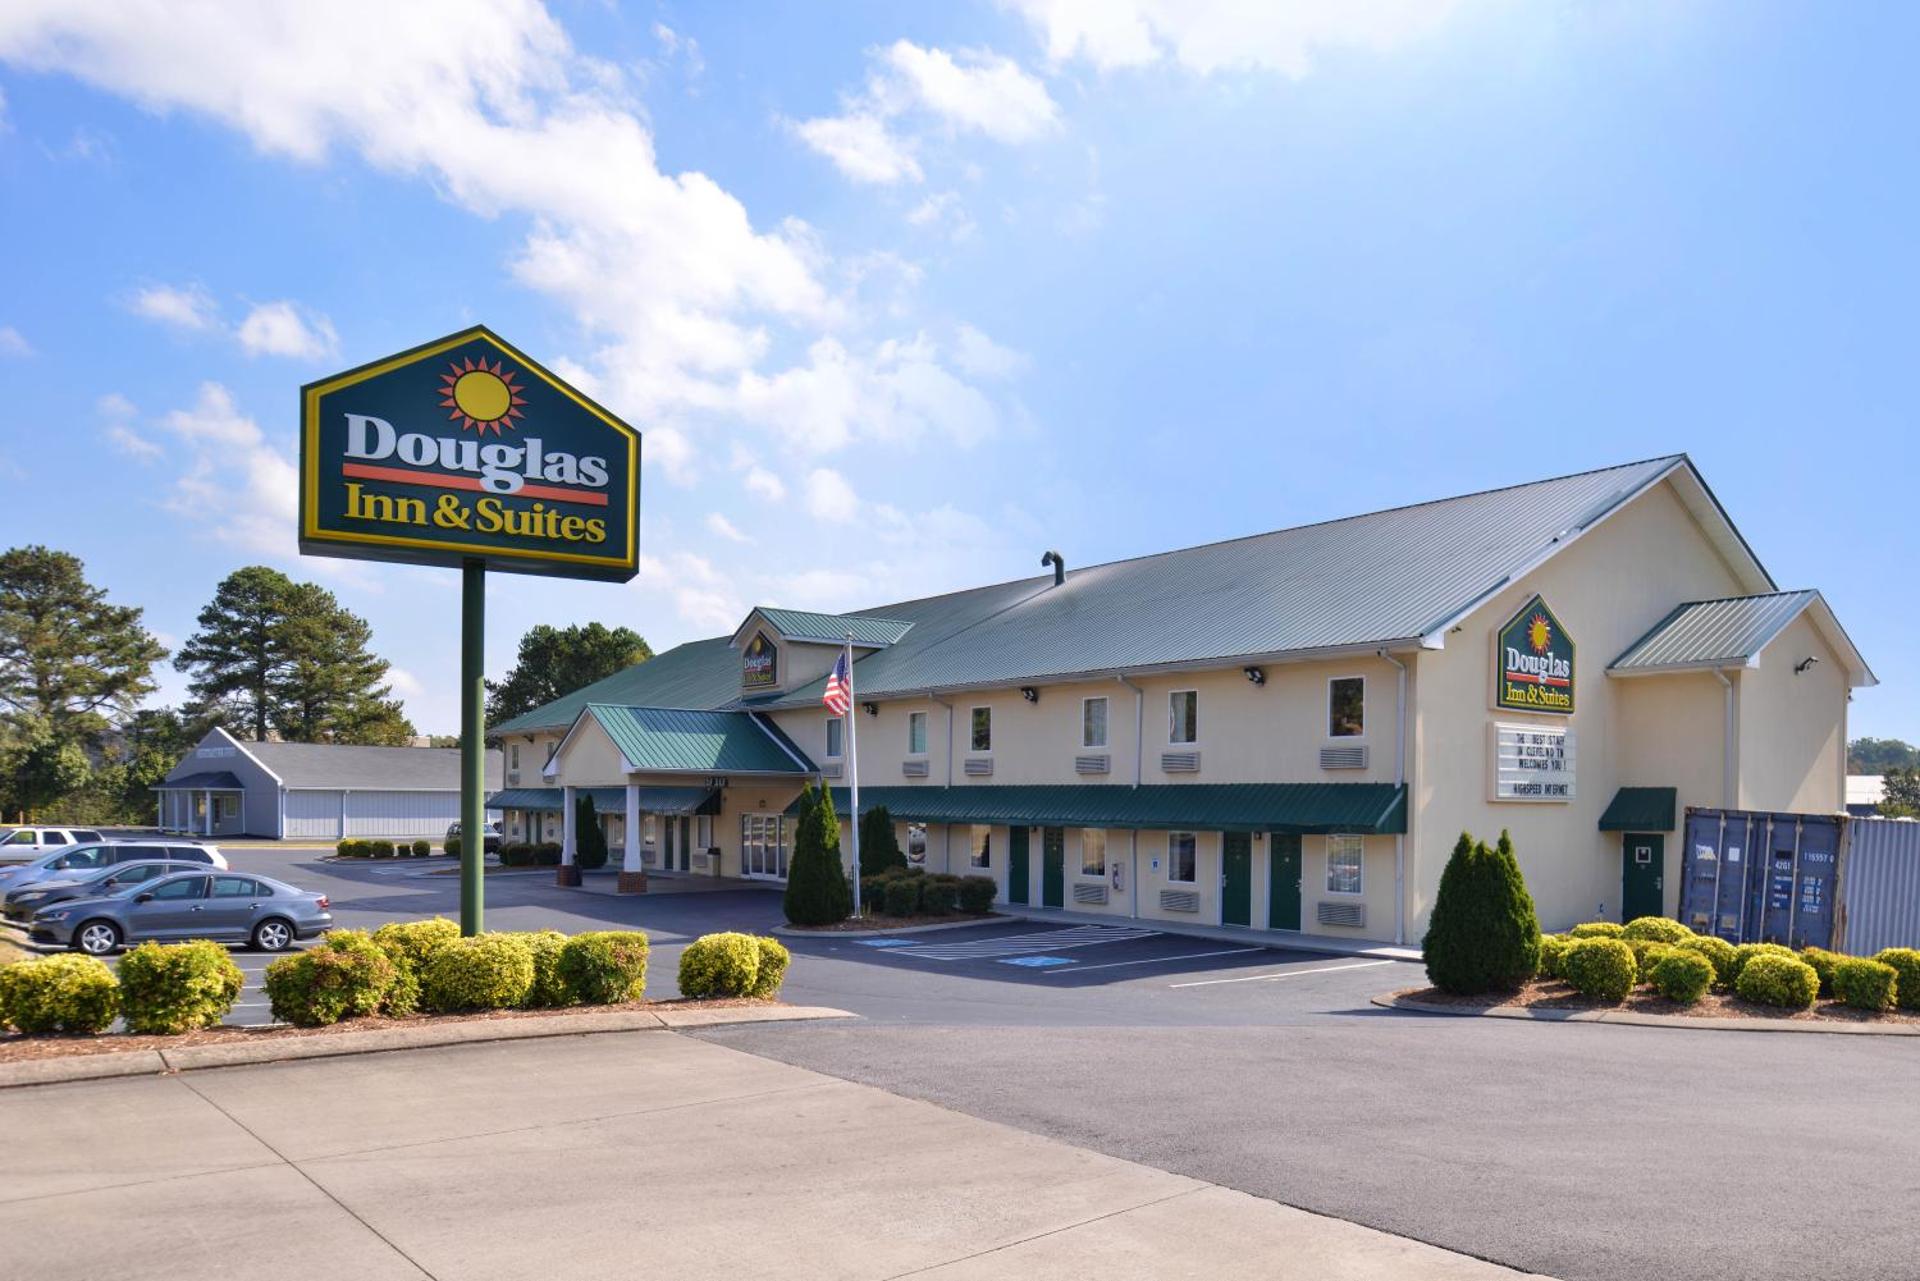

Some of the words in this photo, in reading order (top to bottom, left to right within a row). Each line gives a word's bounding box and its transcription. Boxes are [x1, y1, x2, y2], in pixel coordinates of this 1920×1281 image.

[343, 413, 609, 495] Douglas
[344, 483, 428, 525] Inn
[433, 494, 471, 530] &
[476, 498, 606, 543] Suites
[1506, 647, 1570, 684] Douglas
[1506, 682, 1526, 702] Inn
[1527, 684, 1538, 703] &
[1539, 686, 1570, 706] Suites
[1519, 758, 1548, 770] WELCOMES
